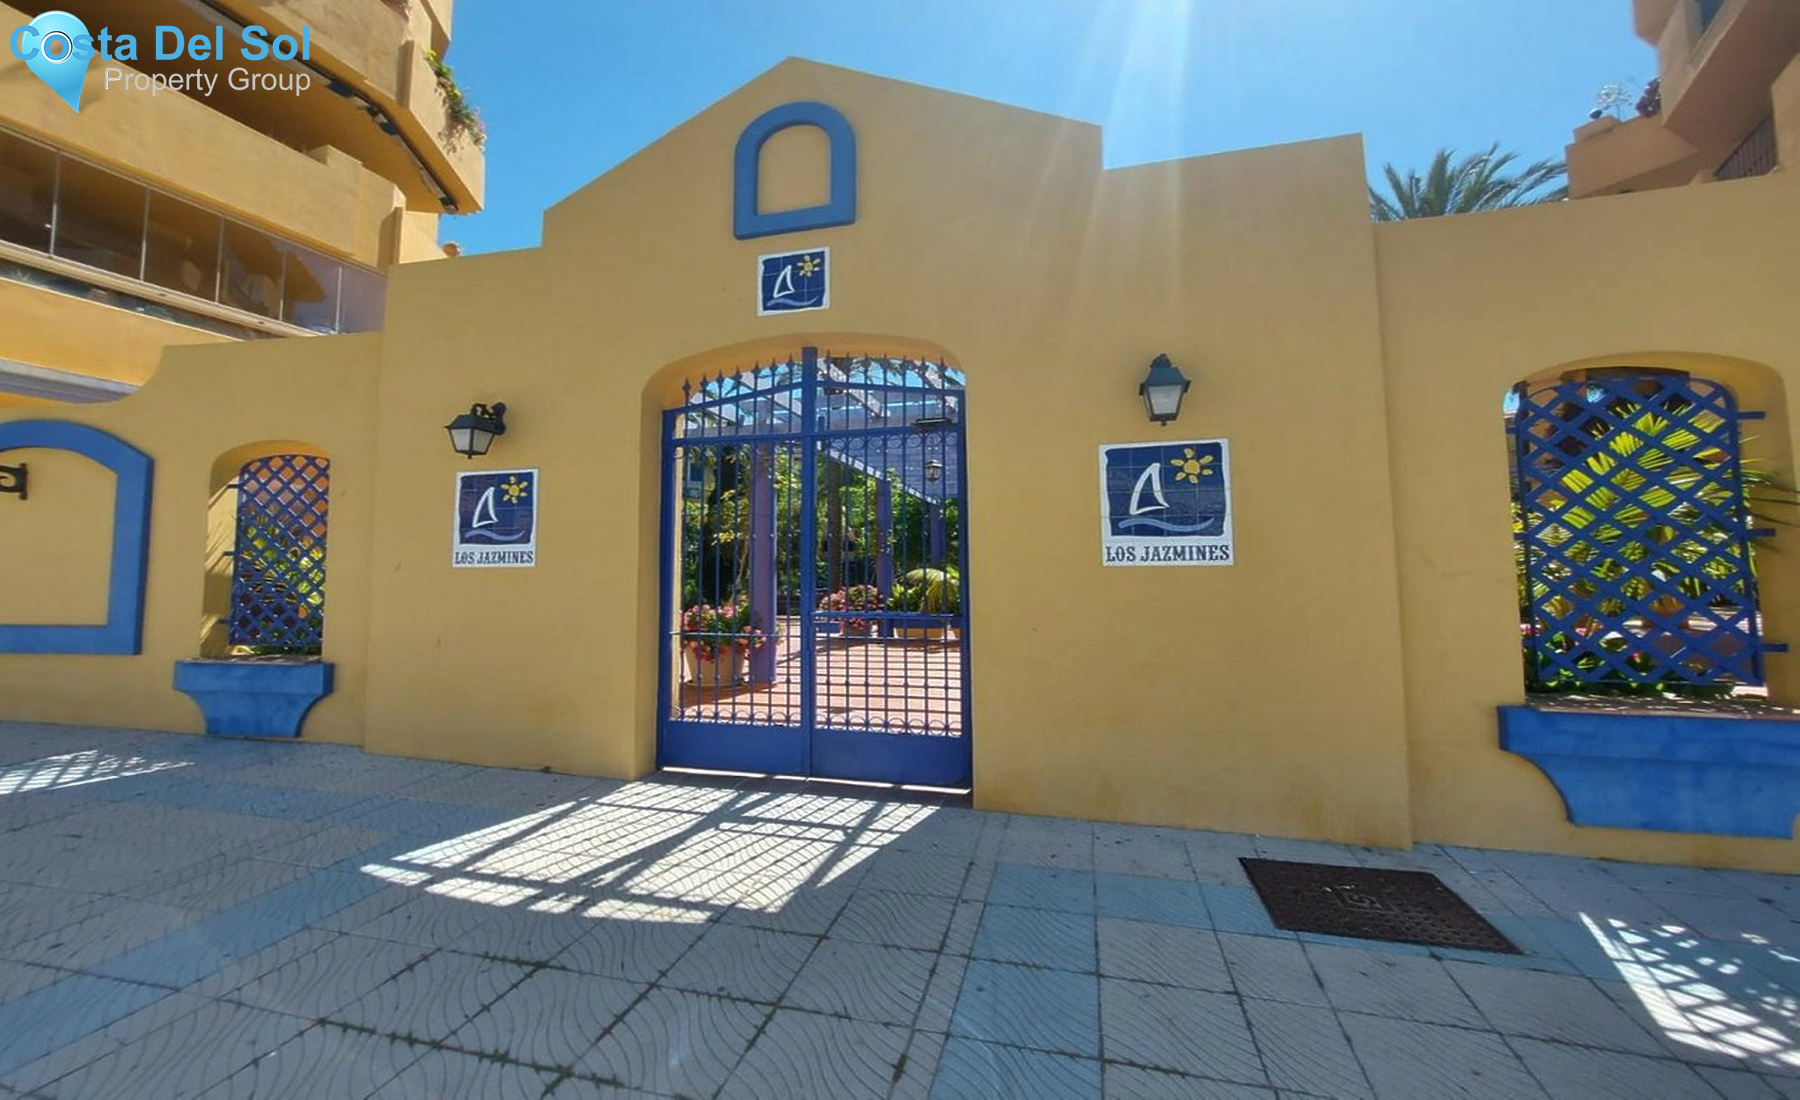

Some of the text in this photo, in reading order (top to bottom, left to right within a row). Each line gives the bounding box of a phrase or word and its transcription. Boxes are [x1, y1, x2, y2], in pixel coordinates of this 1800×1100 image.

[455, 550, 534, 565] LOS JAZMINES
[1105, 545, 1230, 562] LOS JAZMINES
